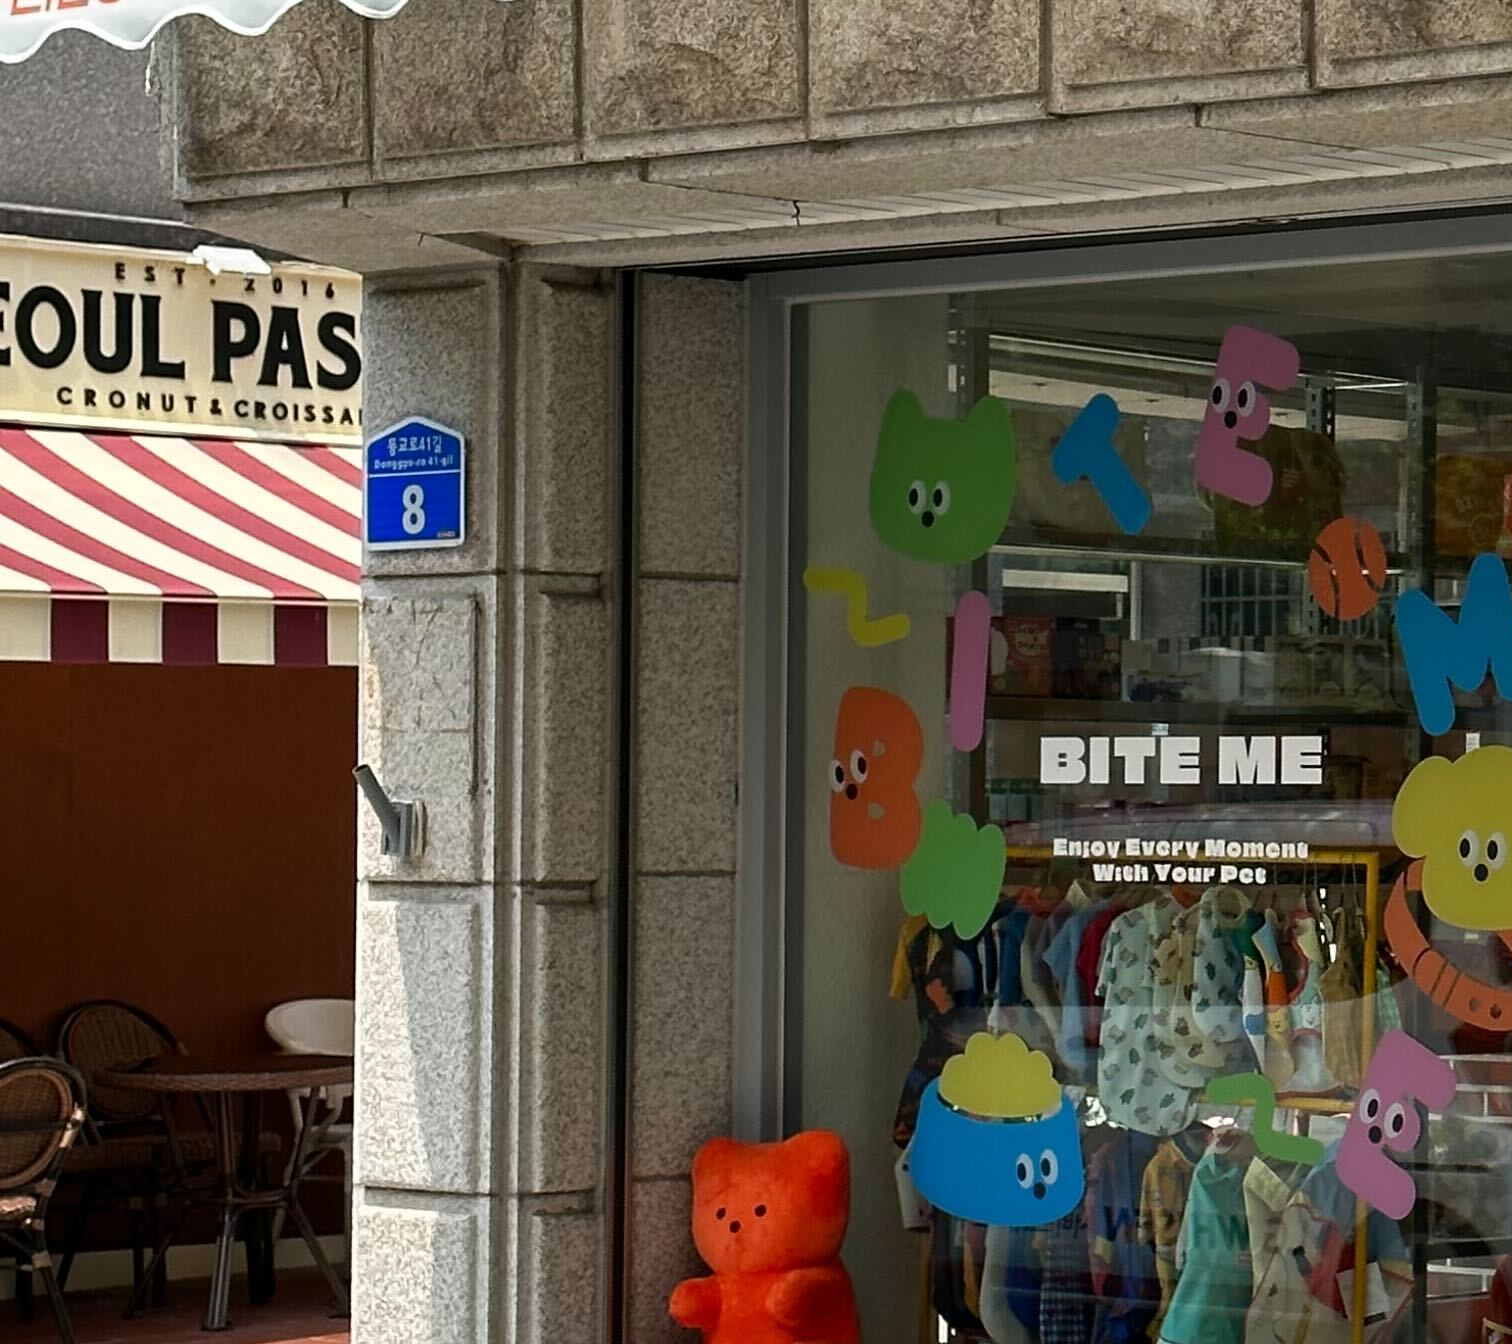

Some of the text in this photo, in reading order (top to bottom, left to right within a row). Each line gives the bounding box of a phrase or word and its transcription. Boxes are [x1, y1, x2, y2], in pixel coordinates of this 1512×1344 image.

[211, 299, 361, 391] PAS
[56, 386, 198, 414] CRONUT
[209, 398, 223, 416] &
[402, 484, 425, 535] 8
[1040, 736, 1323, 784] BITE ME
[1053, 838, 1309, 860] Enjoy Every Moment
[1093, 864, 1266, 884] With Your Pet
